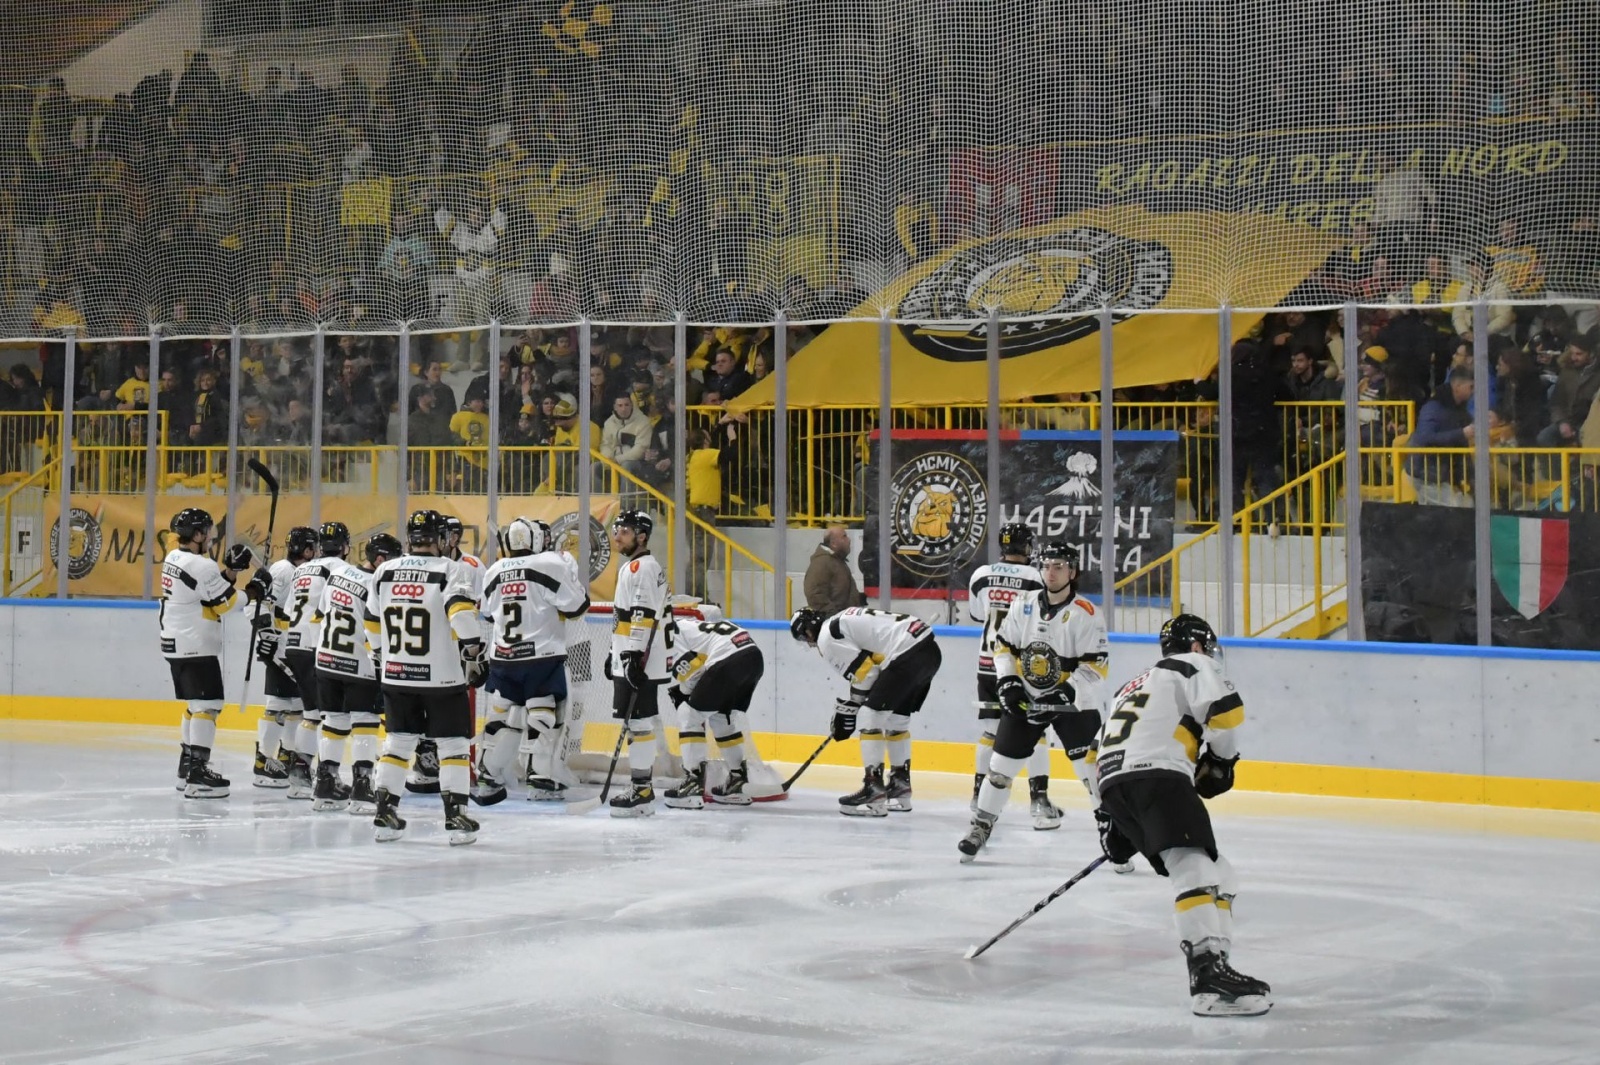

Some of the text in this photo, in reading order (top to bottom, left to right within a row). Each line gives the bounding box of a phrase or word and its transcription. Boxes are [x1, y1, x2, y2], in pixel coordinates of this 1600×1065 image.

[1093, 139, 1568, 196] RAGAZZI DELA NORD
[916, 456, 960, 473] HCMV
[69, 509, 88, 520] CMV
[966, 482, 987, 549] HOCKEY
[18, 531, 31, 553] F
[594, 530, 611, 572] HOCKEY
[400, 559, 428, 567] VIVO
[990, 564, 1020, 574] VIVO
[393, 570, 430, 582] BERTIN
[500, 569, 526, 582] PERLA
[987, 576, 1022, 589] TILARO
[331, 575, 366, 597] FRANCHINI
[392, 584, 425, 598] coop
[501, 582, 526, 595] coop
[332, 590, 352, 606] coop
[503, 602, 522, 644] 2
[321, 607, 356, 654] 12
[384, 606, 431, 656] 69
[333, 656, 358, 666] Novauto
[676, 660, 692, 676] 88
[402, 665, 429, 673] Novauto
[1033, 703, 1055, 711] CCM
[1068, 746, 1091, 756] CCM
